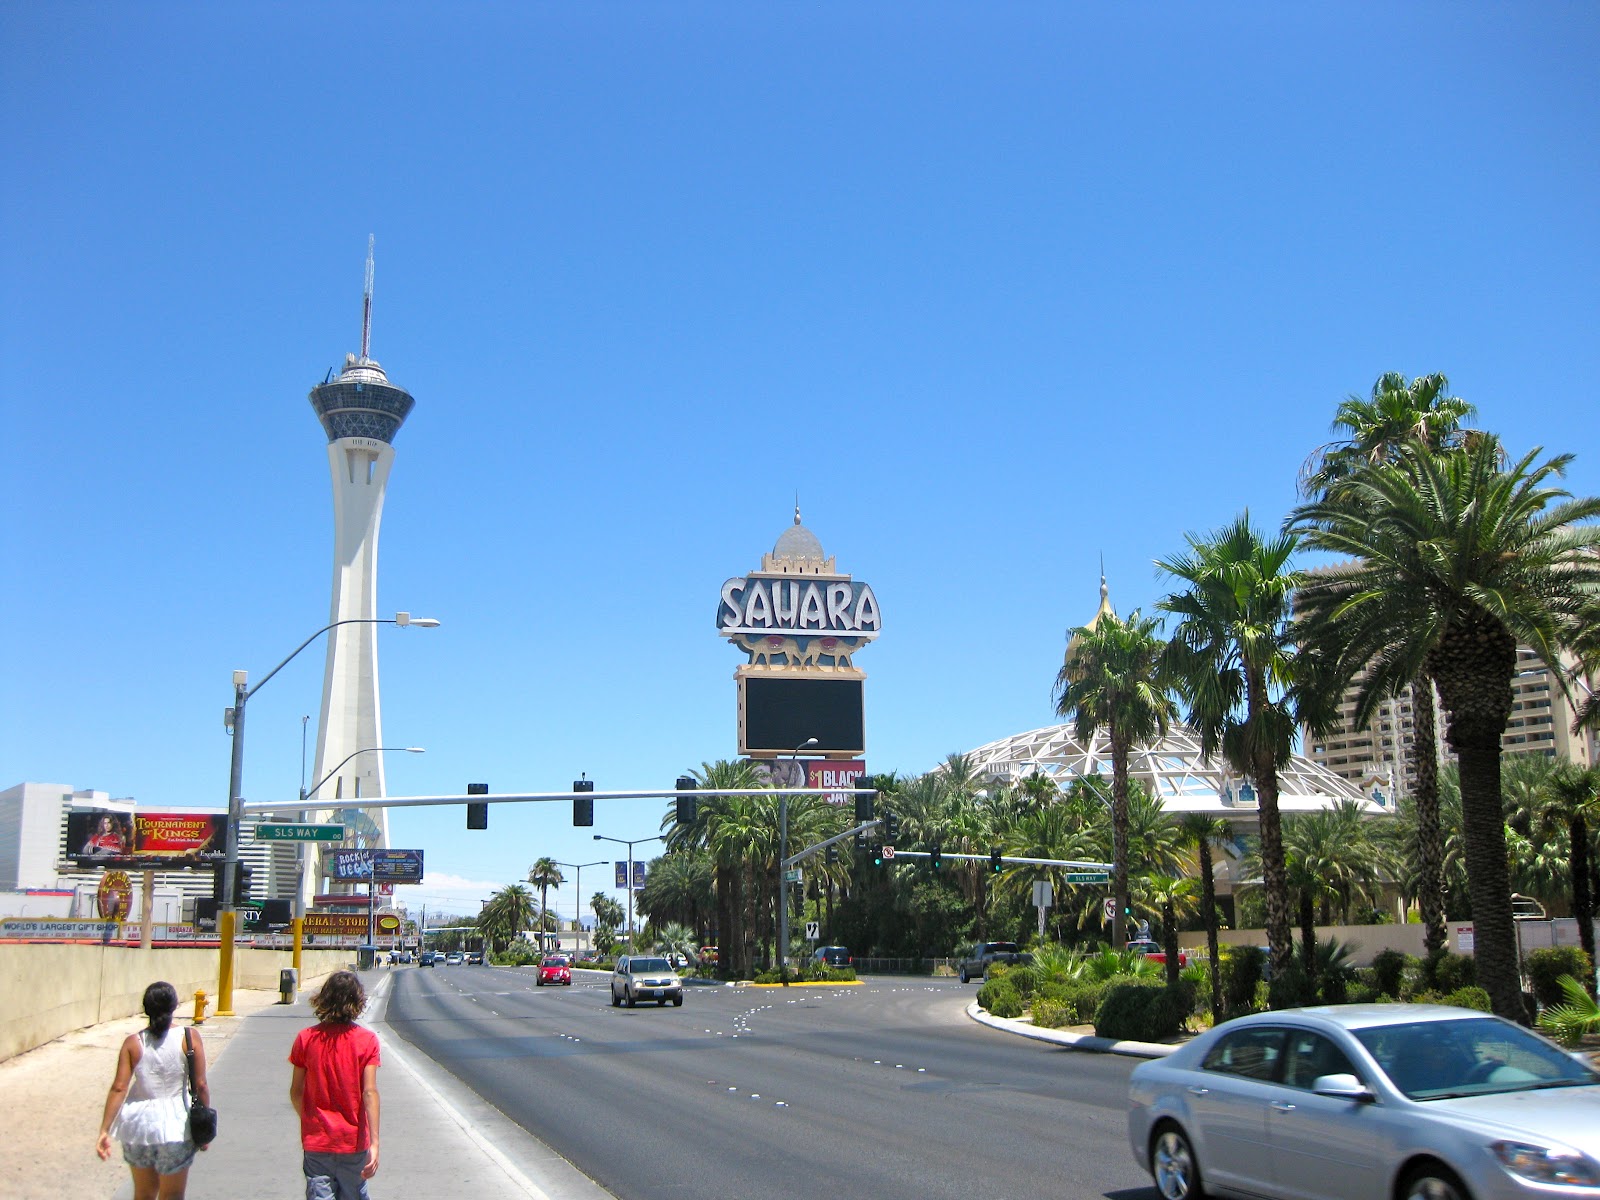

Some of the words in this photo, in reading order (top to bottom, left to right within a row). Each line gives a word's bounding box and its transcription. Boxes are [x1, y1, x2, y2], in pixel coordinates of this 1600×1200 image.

[721, 577, 881, 631] SAHARA
[137, 817, 207, 830] TOURNAMENT
[152, 829, 200, 840] KINGS
[274, 828, 294, 837] SLS
[296, 828, 319, 837] WAY
[200, 849, 226, 859] Excalibu
[339, 852, 361, 865] ROCK
[302, 917, 336, 926] NERAL
[4, 923, 37, 931] WORLD'S
[40, 923, 77, 931] LARGEST
[78, 923, 96, 931] GIFT
